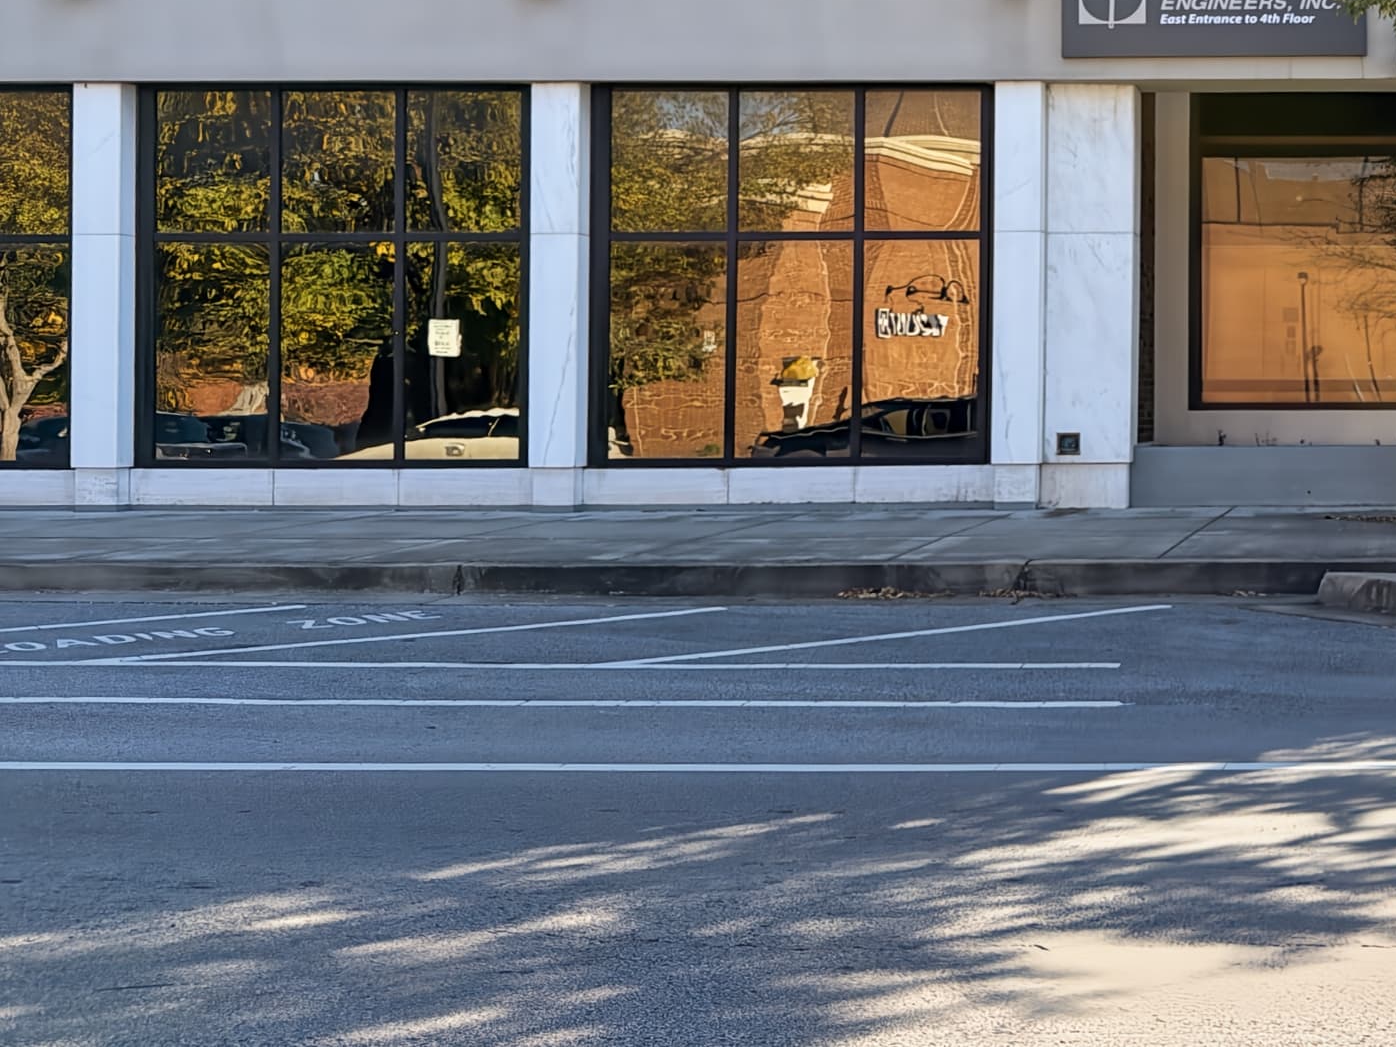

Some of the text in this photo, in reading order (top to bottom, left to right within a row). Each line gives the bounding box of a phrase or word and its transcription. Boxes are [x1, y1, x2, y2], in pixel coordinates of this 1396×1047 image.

[1160, 13, 1315, 25] East Entrance to 4th Floor
[1, 610, 441, 653] OADING ZONE
